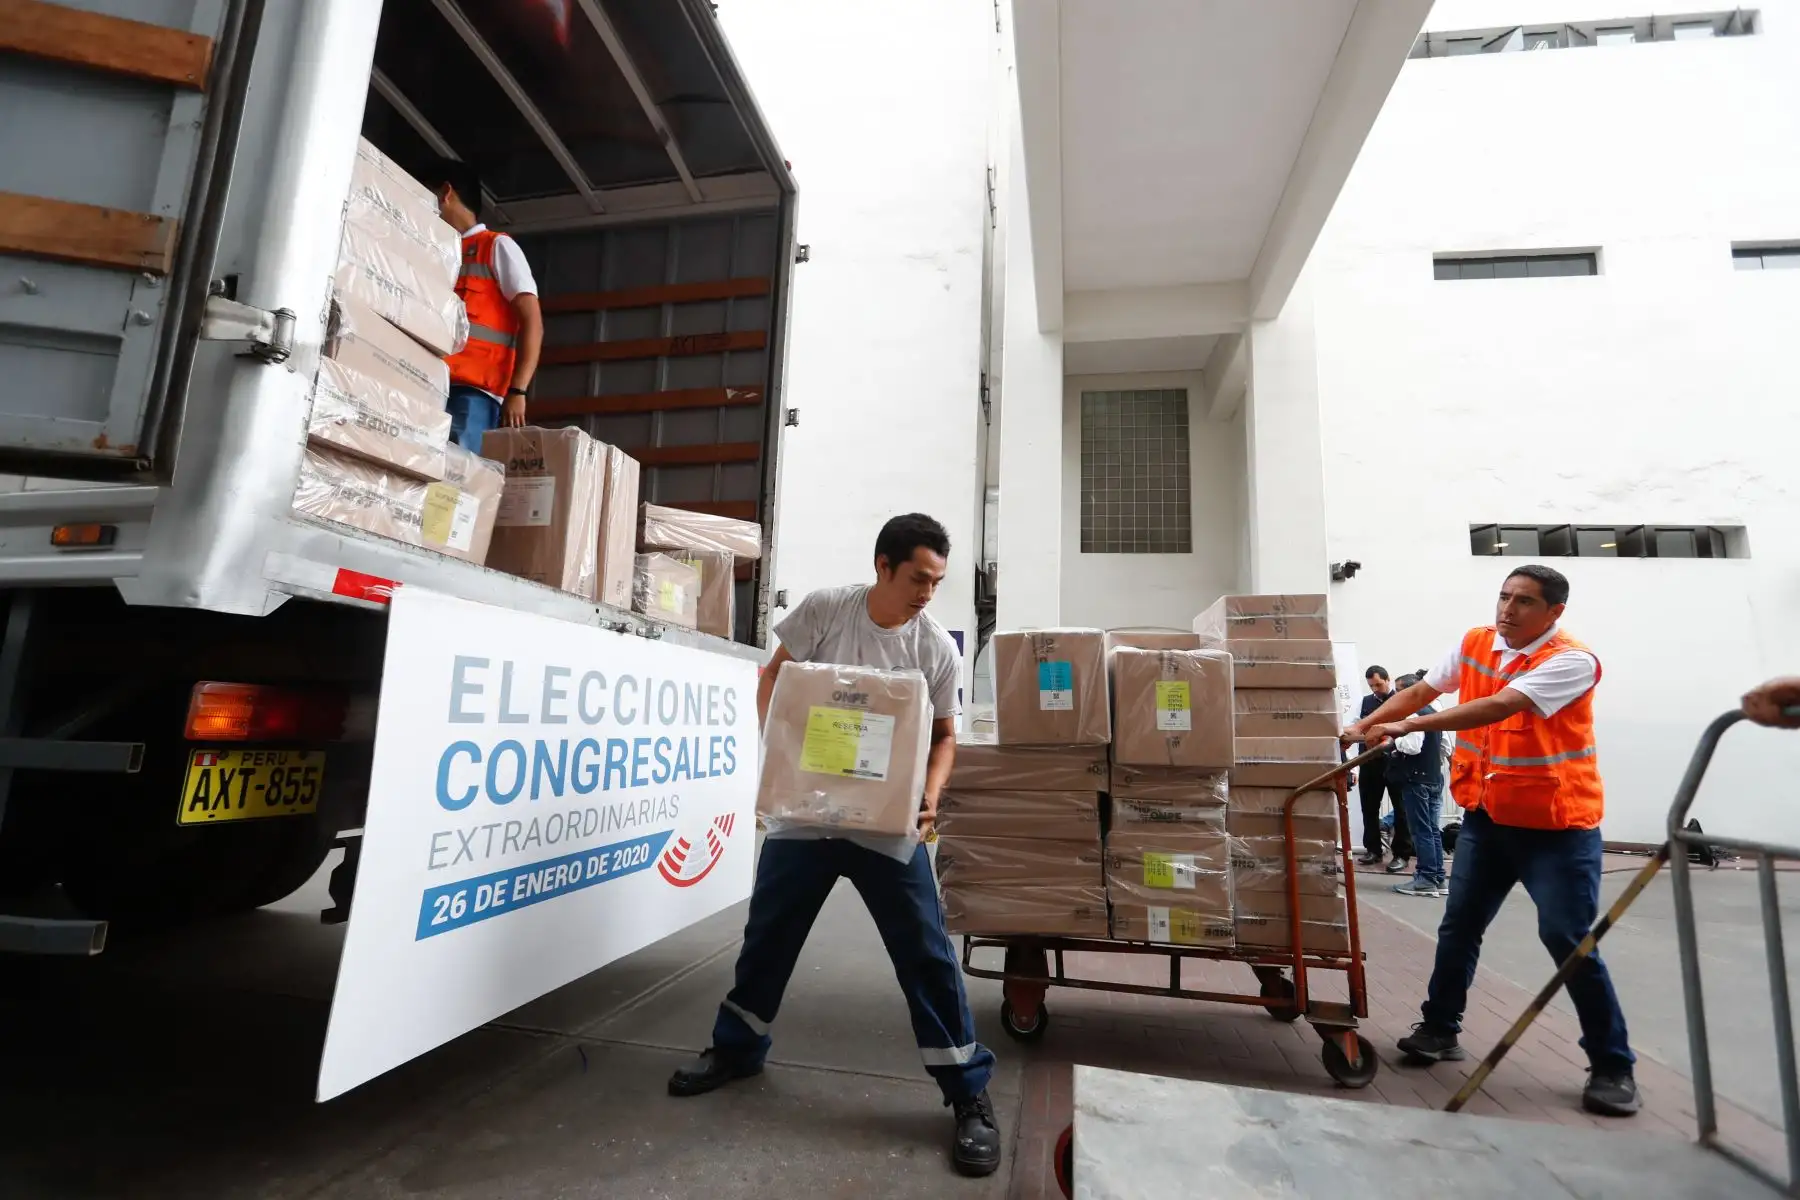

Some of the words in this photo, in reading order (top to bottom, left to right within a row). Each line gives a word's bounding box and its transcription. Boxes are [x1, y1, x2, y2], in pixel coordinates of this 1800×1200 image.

[356, 411, 400, 438] ONPE
[508, 457, 545, 471] ONPE
[393, 507, 424, 529] NPE
[448, 654, 738, 727] ELECCIONES
[832, 690, 869, 705] ONPE
[832, 721, 869, 733] RESERVA
[240, 752, 288, 766] PERU
[436, 735, 737, 812] CONGRESALES
[188, 766, 318, 812] AXT-855
[1151, 811, 1182, 821] ONPE
[427, 794, 680, 871] EXTRAORDINARIAS
[431, 891, 467, 926] 26
[474, 879, 505, 914] DE
[512, 860, 583, 900] ENERO
[586, 852, 608, 877] DE
[612, 842, 650, 873] 2020
